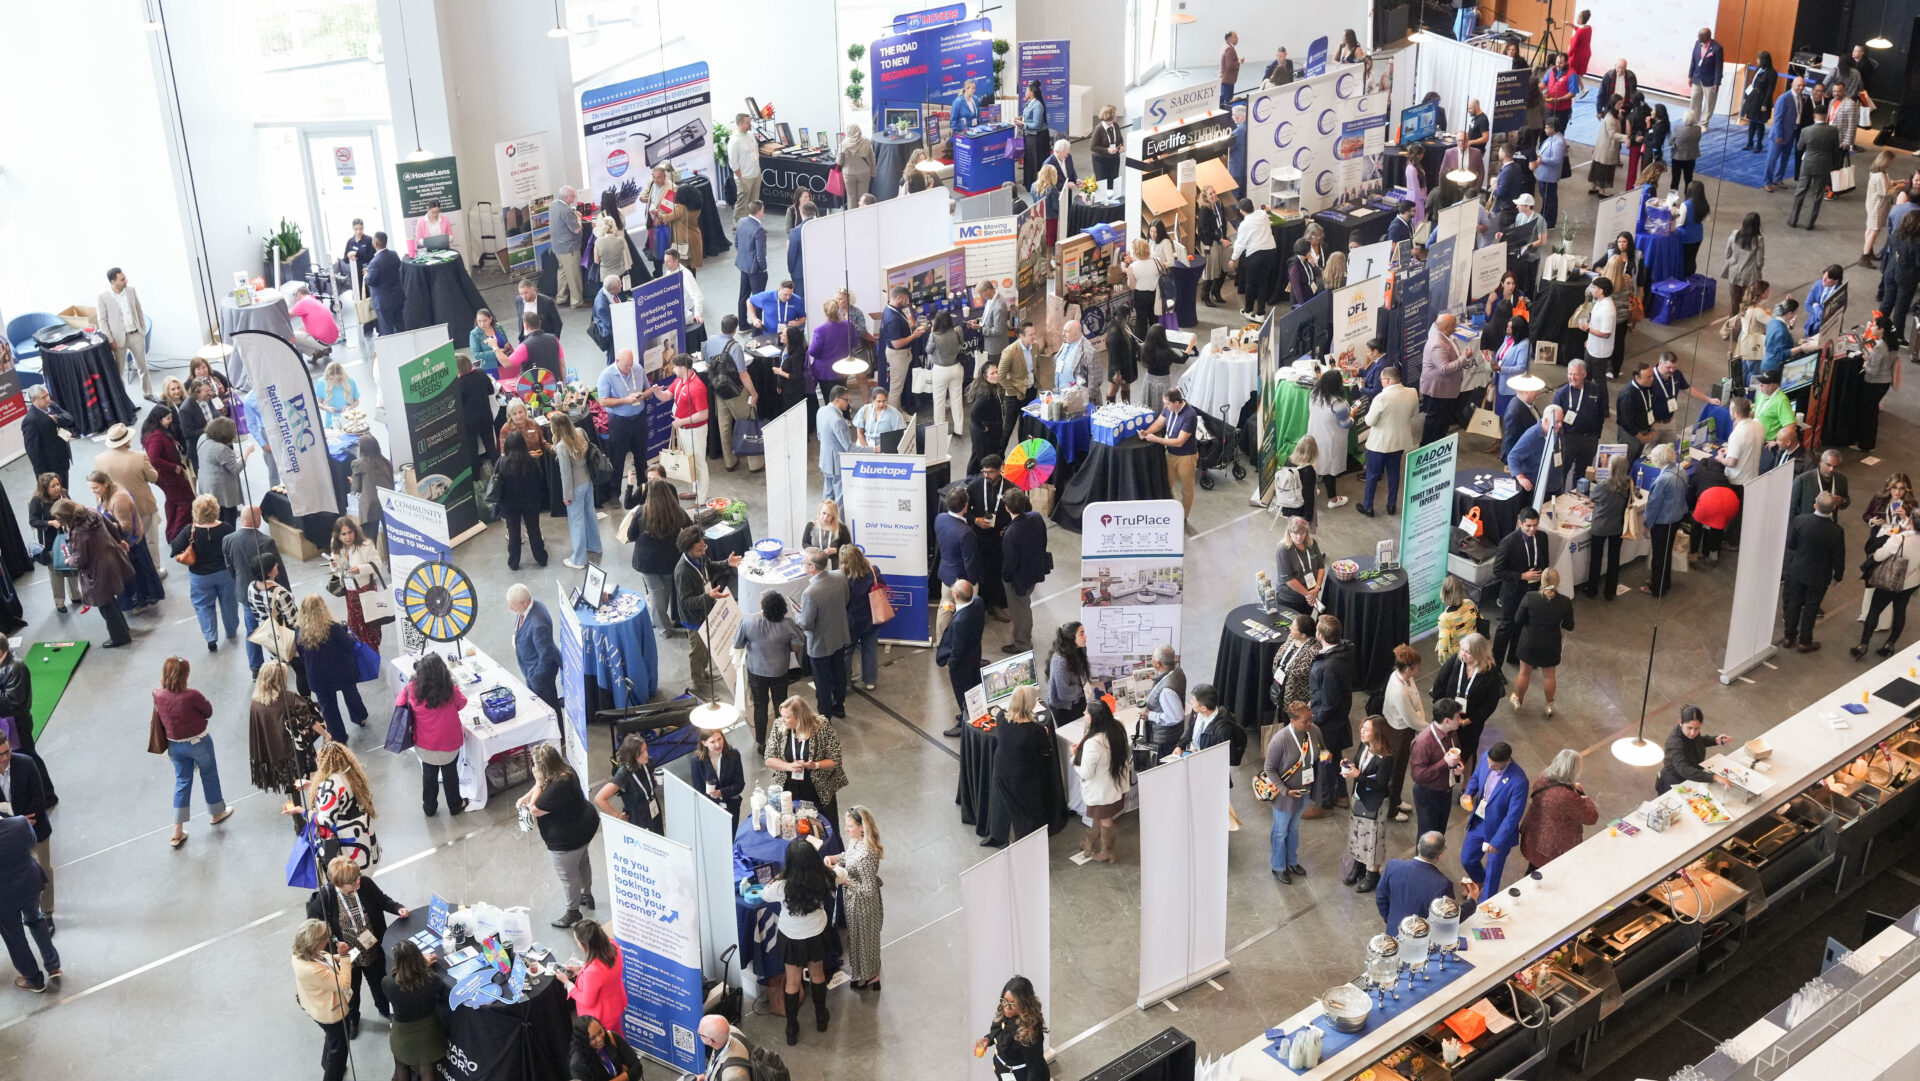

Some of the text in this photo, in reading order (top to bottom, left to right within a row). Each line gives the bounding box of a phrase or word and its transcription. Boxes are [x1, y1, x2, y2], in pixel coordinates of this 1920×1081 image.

[922, 9, 959, 25] MOVERS
[880, 42, 918, 57] THE ROAD
[880, 56, 911, 70] TO NEW
[881, 64, 929, 82] BEGINNINGS
[1170, 86, 1217, 109] SAROKEY
[1500, 98, 1524, 106] Button
[1147, 132, 1187, 156] Everlife
[412, 169, 451, 180] HouseLens
[762, 168, 827, 193] CUTCO
[762, 188, 794, 198] CLOSIN
[960, 226, 982, 239] MG
[984, 223, 1008, 231] Moving
[644, 282, 681, 301] Constant Contact
[640, 299, 680, 319] Marketing tools
[647, 311, 667, 325] tailored
[1348, 302, 1368, 318] DFL
[643, 326, 655, 337] your
[409, 367, 449, 394] RELOCATION
[411, 362, 446, 385] FOR ALL YOUR
[419, 381, 443, 399] NEEDS!
[266, 384, 300, 474] Ratified Title Group
[1416, 441, 1454, 466] RADON
[860, 464, 908, 478] bluetape
[1412, 466, 1431, 478] Realtors
[1438, 456, 1452, 467] Source
[1429, 468, 1442, 478] Radon
[1410, 480, 1451, 504] TRUST THE RADON
[1419, 492, 1441, 508] EXPERTS!
[394, 500, 441, 519] COMMUNITY
[1114, 514, 1171, 526] TruPlace
[387, 532, 438, 554] CLOSE TO HOME.
[1417, 602, 1442, 619] DEFENSE
[1418, 600, 1437, 613] RADON
[613, 852, 649, 873] Are you
[621, 866, 656, 886] Realtor
[614, 874, 662, 899] looking to
[616, 885, 666, 912] boost your
[616, 896, 657, 919] income?
